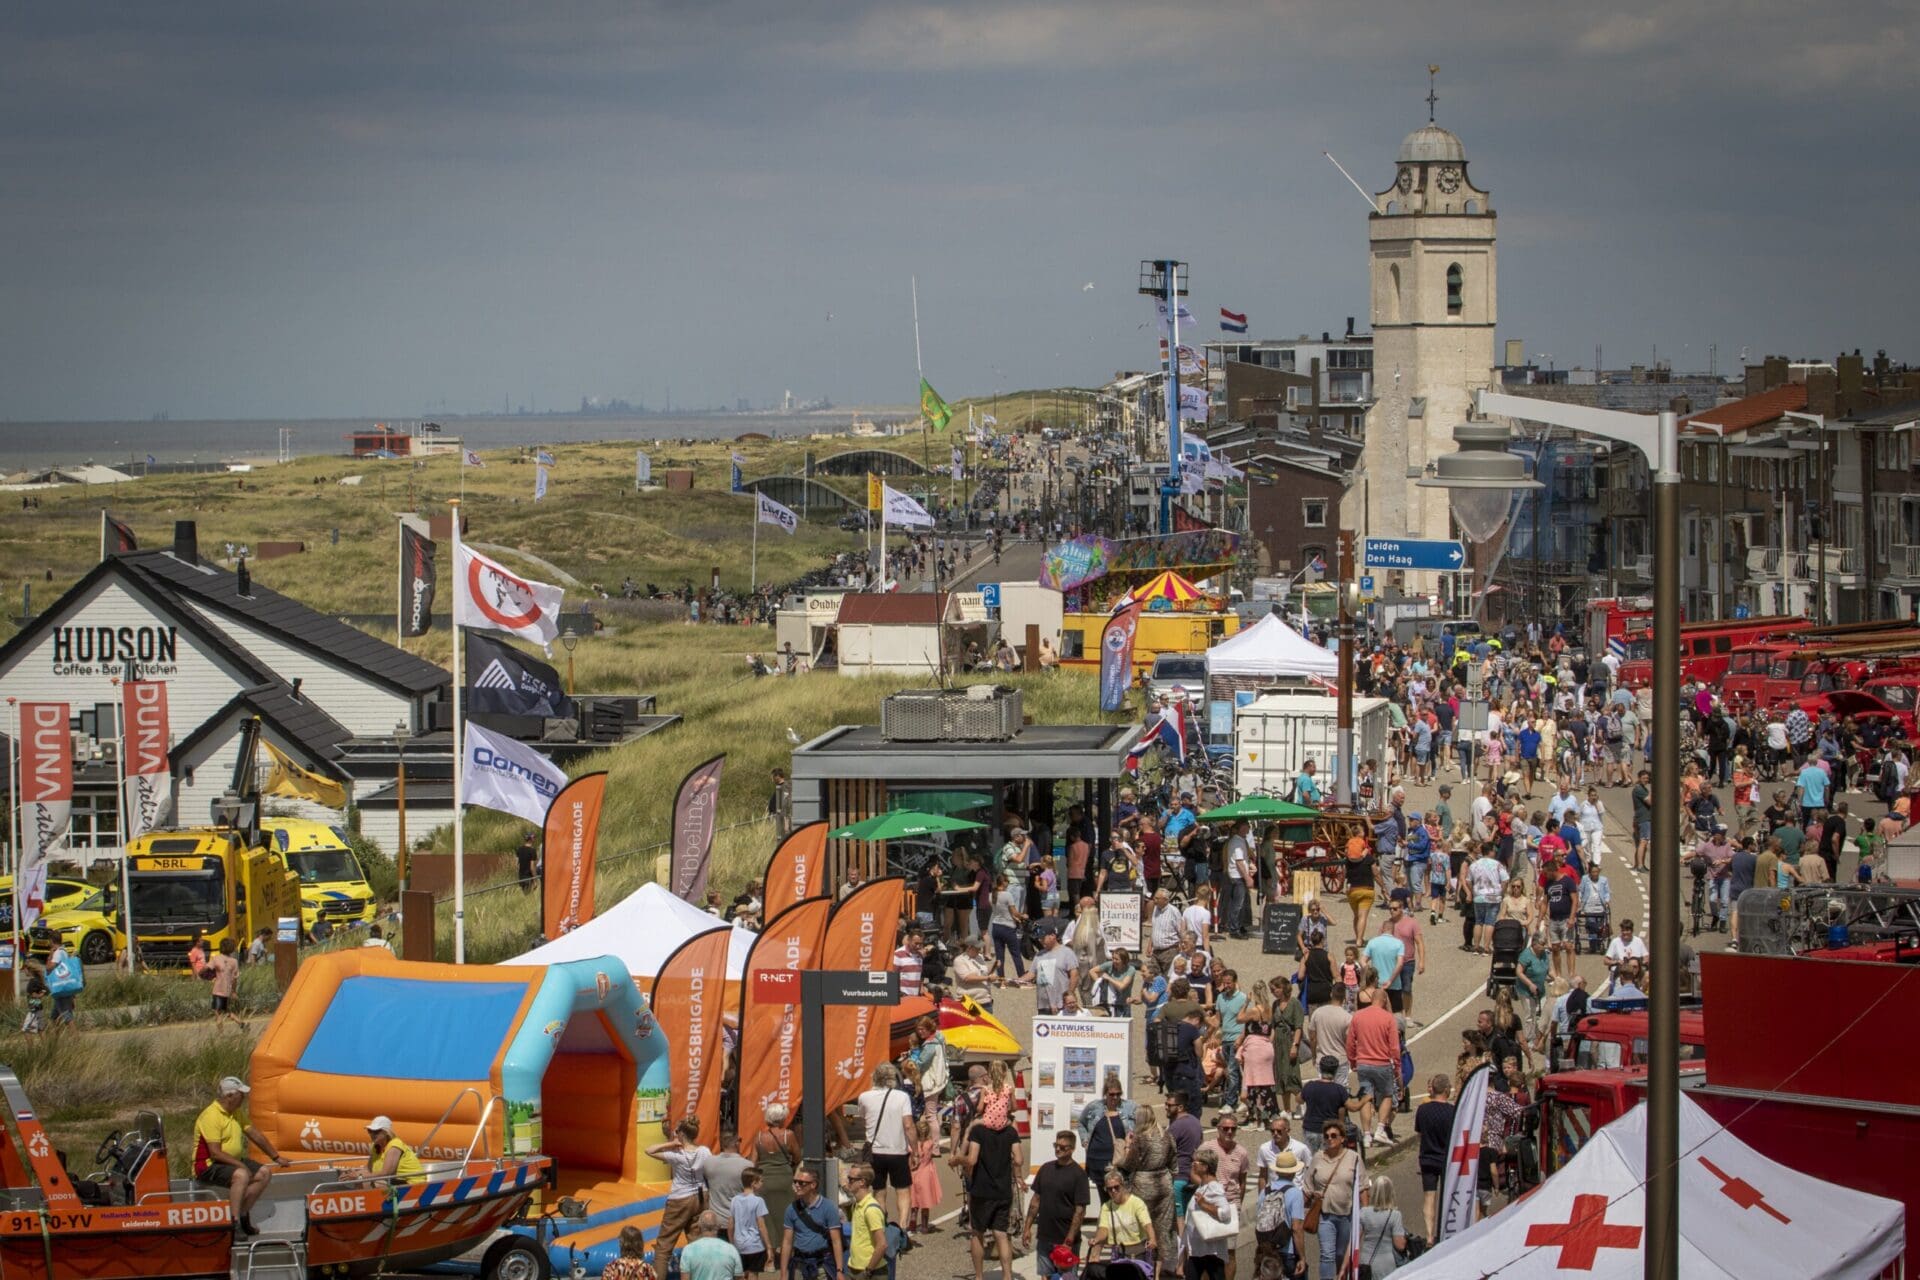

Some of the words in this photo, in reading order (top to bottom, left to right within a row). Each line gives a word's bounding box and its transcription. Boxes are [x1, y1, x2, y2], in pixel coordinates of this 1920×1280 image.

[1367, 542, 1400, 551] Leiden
[1367, 554, 1385, 562] Den
[1388, 554, 1413, 565] Haag
[1362, 578, 1371, 588] P
[53, 627, 177, 662] HUDSON
[53, 664, 93, 675] Coffee
[102, 664, 123, 675] Bar
[135, 684, 161, 773] DUNA
[34, 705, 61, 800] DUNA
[1102, 899, 1137, 909] Nieuwe
[1102, 910, 1138, 921] Haring
[842, 989, 888, 998] Vuurbaakplein
[1050, 1024, 1095, 1032] KATWIJKSE
[1050, 1031, 1125, 1040] REDDINGSBRIGADE
[12, 1214, 92, 1231] 91-0-YV
[122, 1219, 160, 1228] Leiderdorp
